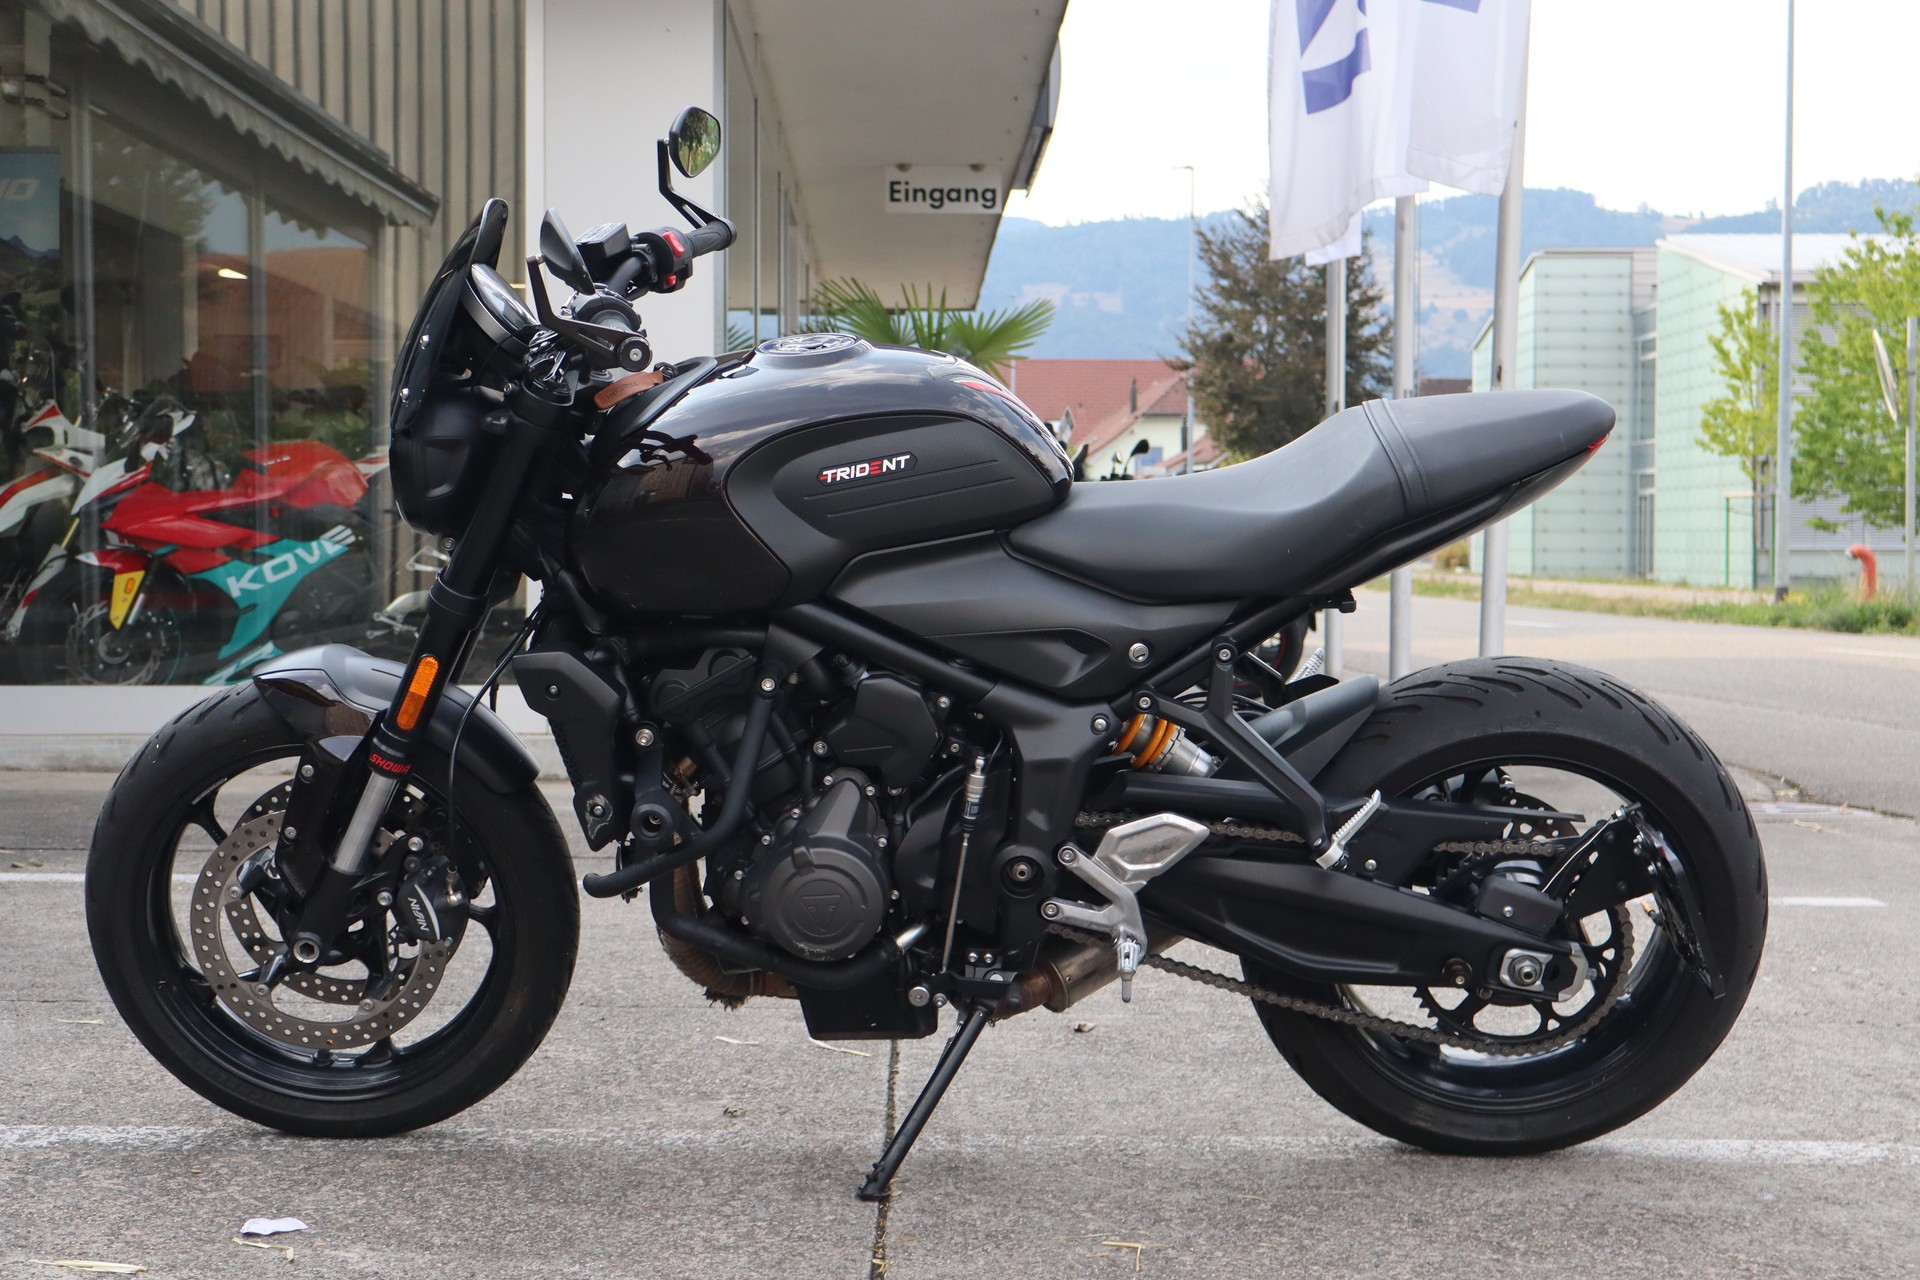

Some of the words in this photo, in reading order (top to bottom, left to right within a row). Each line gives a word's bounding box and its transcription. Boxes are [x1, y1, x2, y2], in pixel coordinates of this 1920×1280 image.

[889, 181, 996, 209] Eingang
[820, 455, 910, 483] TRIDENT
[226, 524, 356, 598] KOVE
[370, 753, 411, 774] SHOWA
